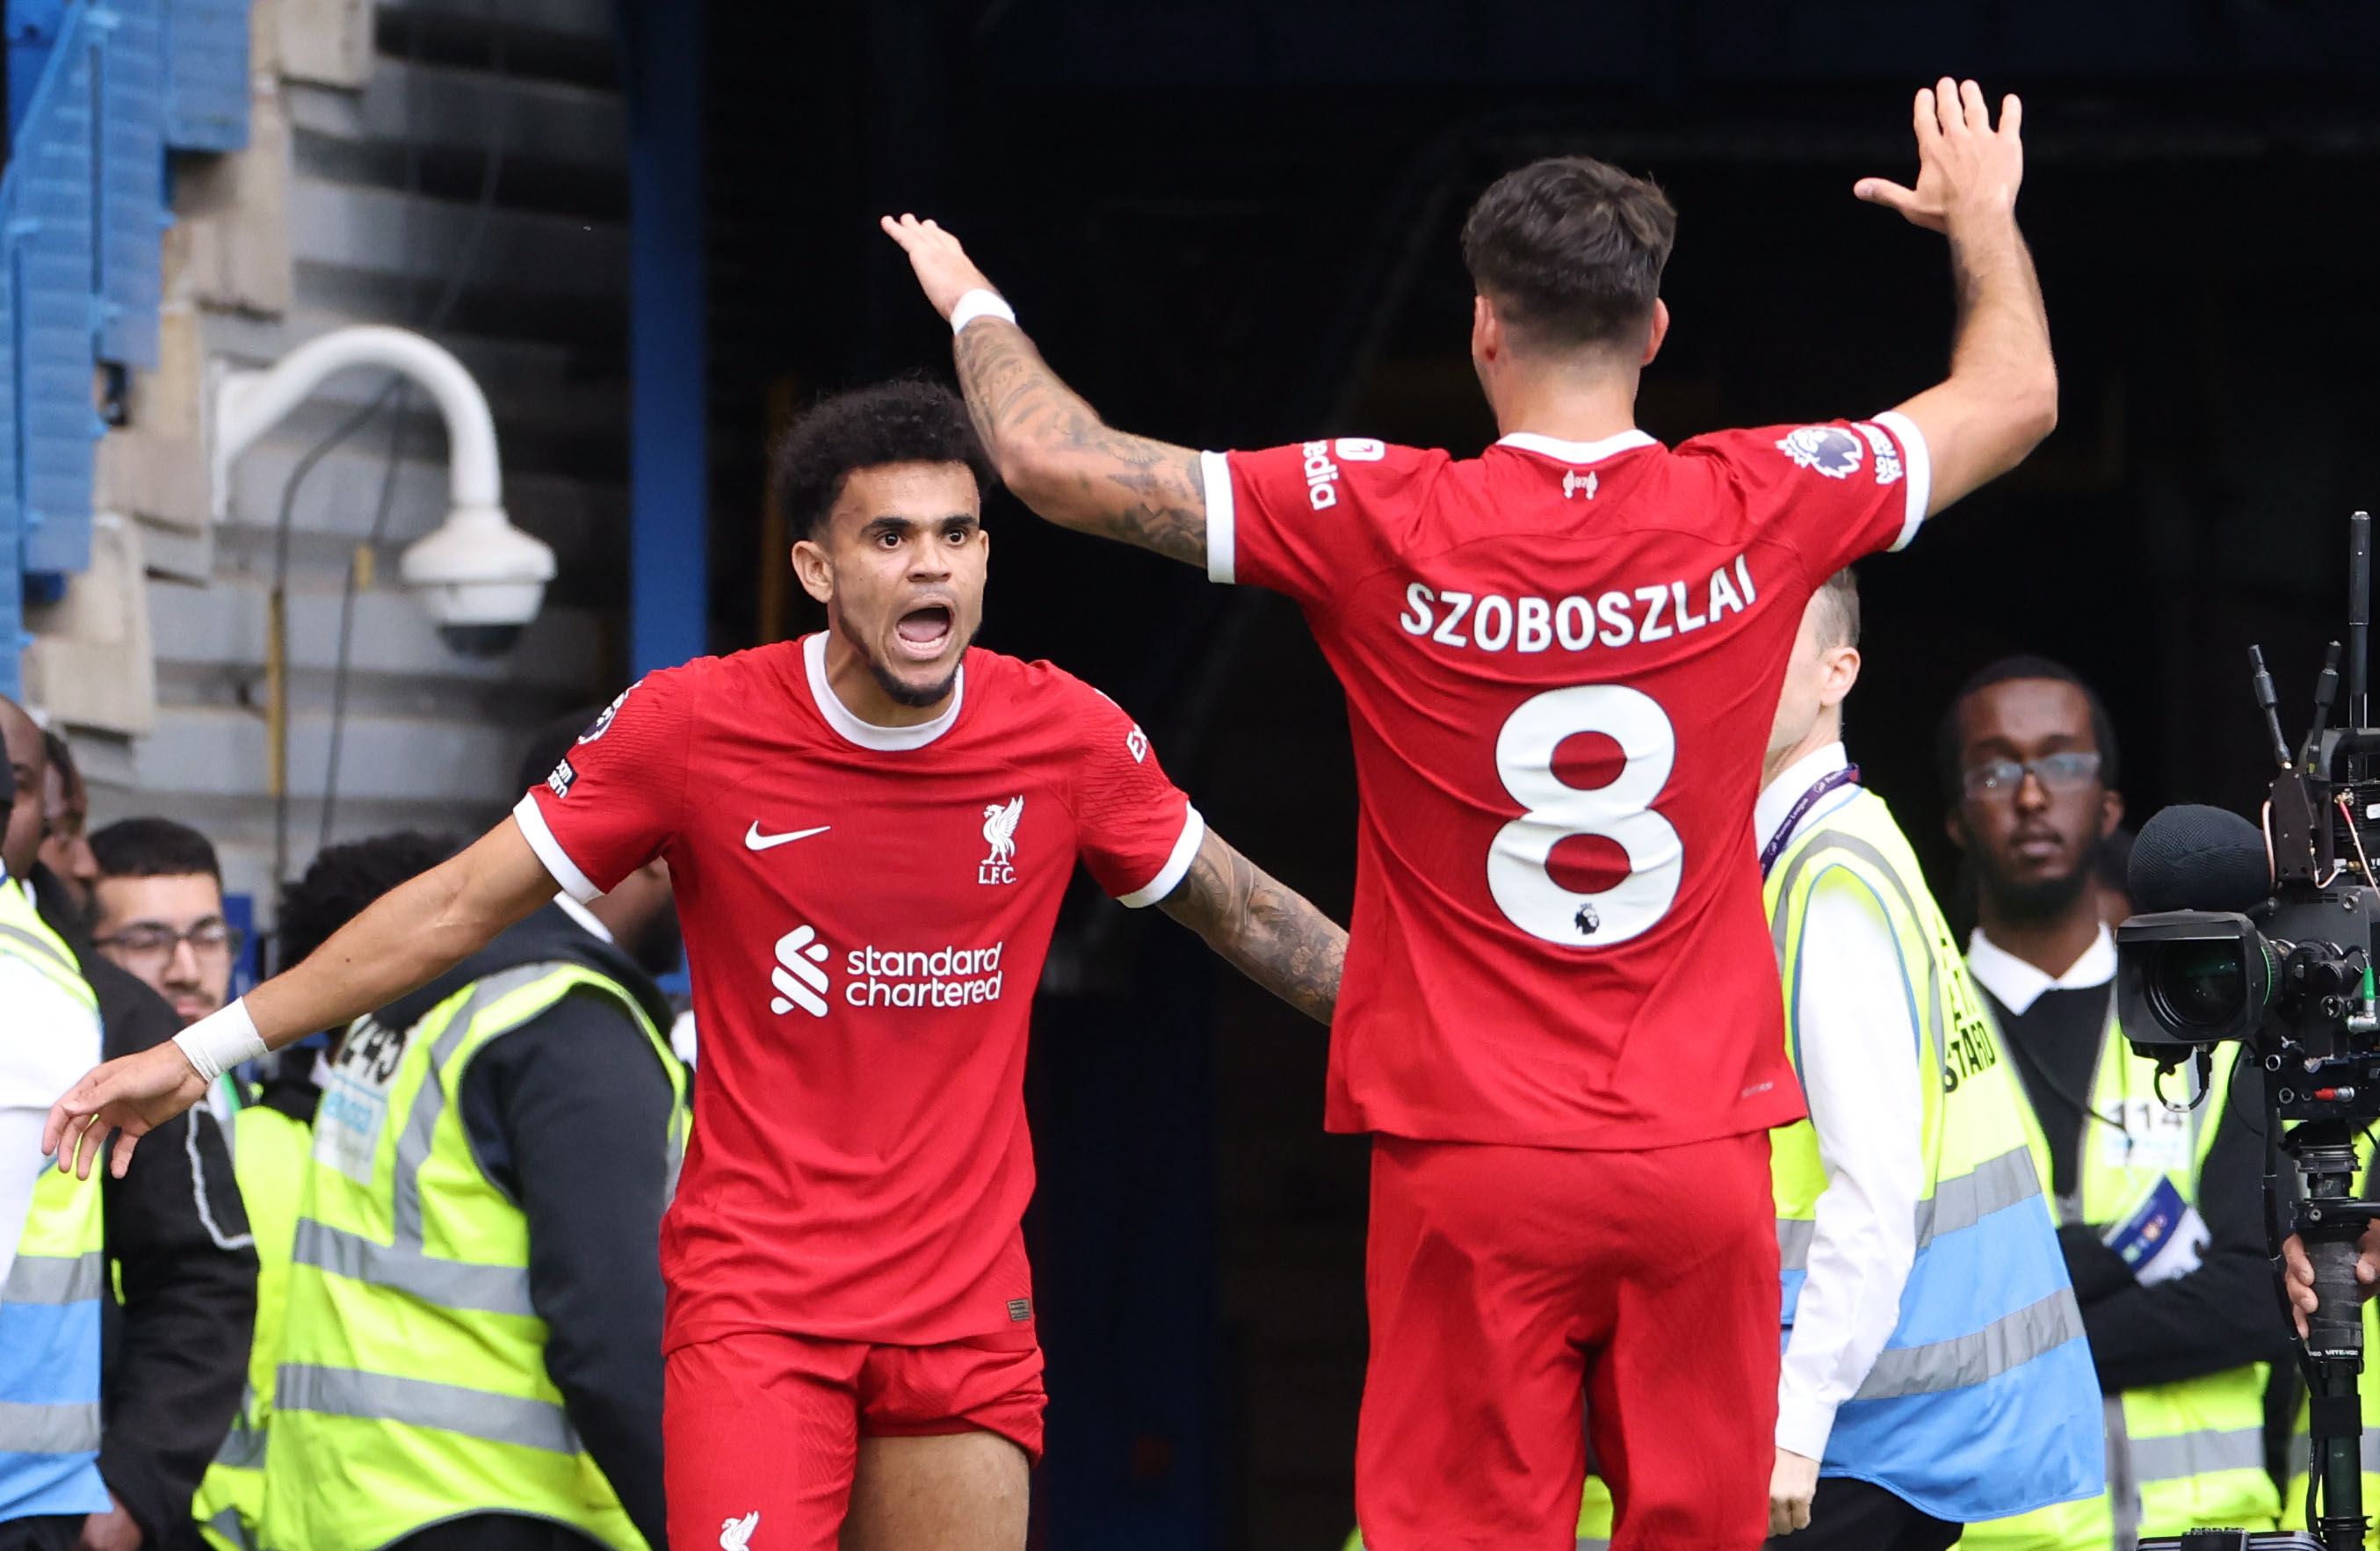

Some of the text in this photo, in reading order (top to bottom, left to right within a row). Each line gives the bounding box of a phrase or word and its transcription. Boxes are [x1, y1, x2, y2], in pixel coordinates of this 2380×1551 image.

[1302, 439, 1339, 511] edia
[1399, 554, 1756, 654] SZOBOSZLAI
[1486, 684, 1684, 947] 8
[845, 970, 1002, 1008] chartered
[846, 941, 1002, 977] standard
